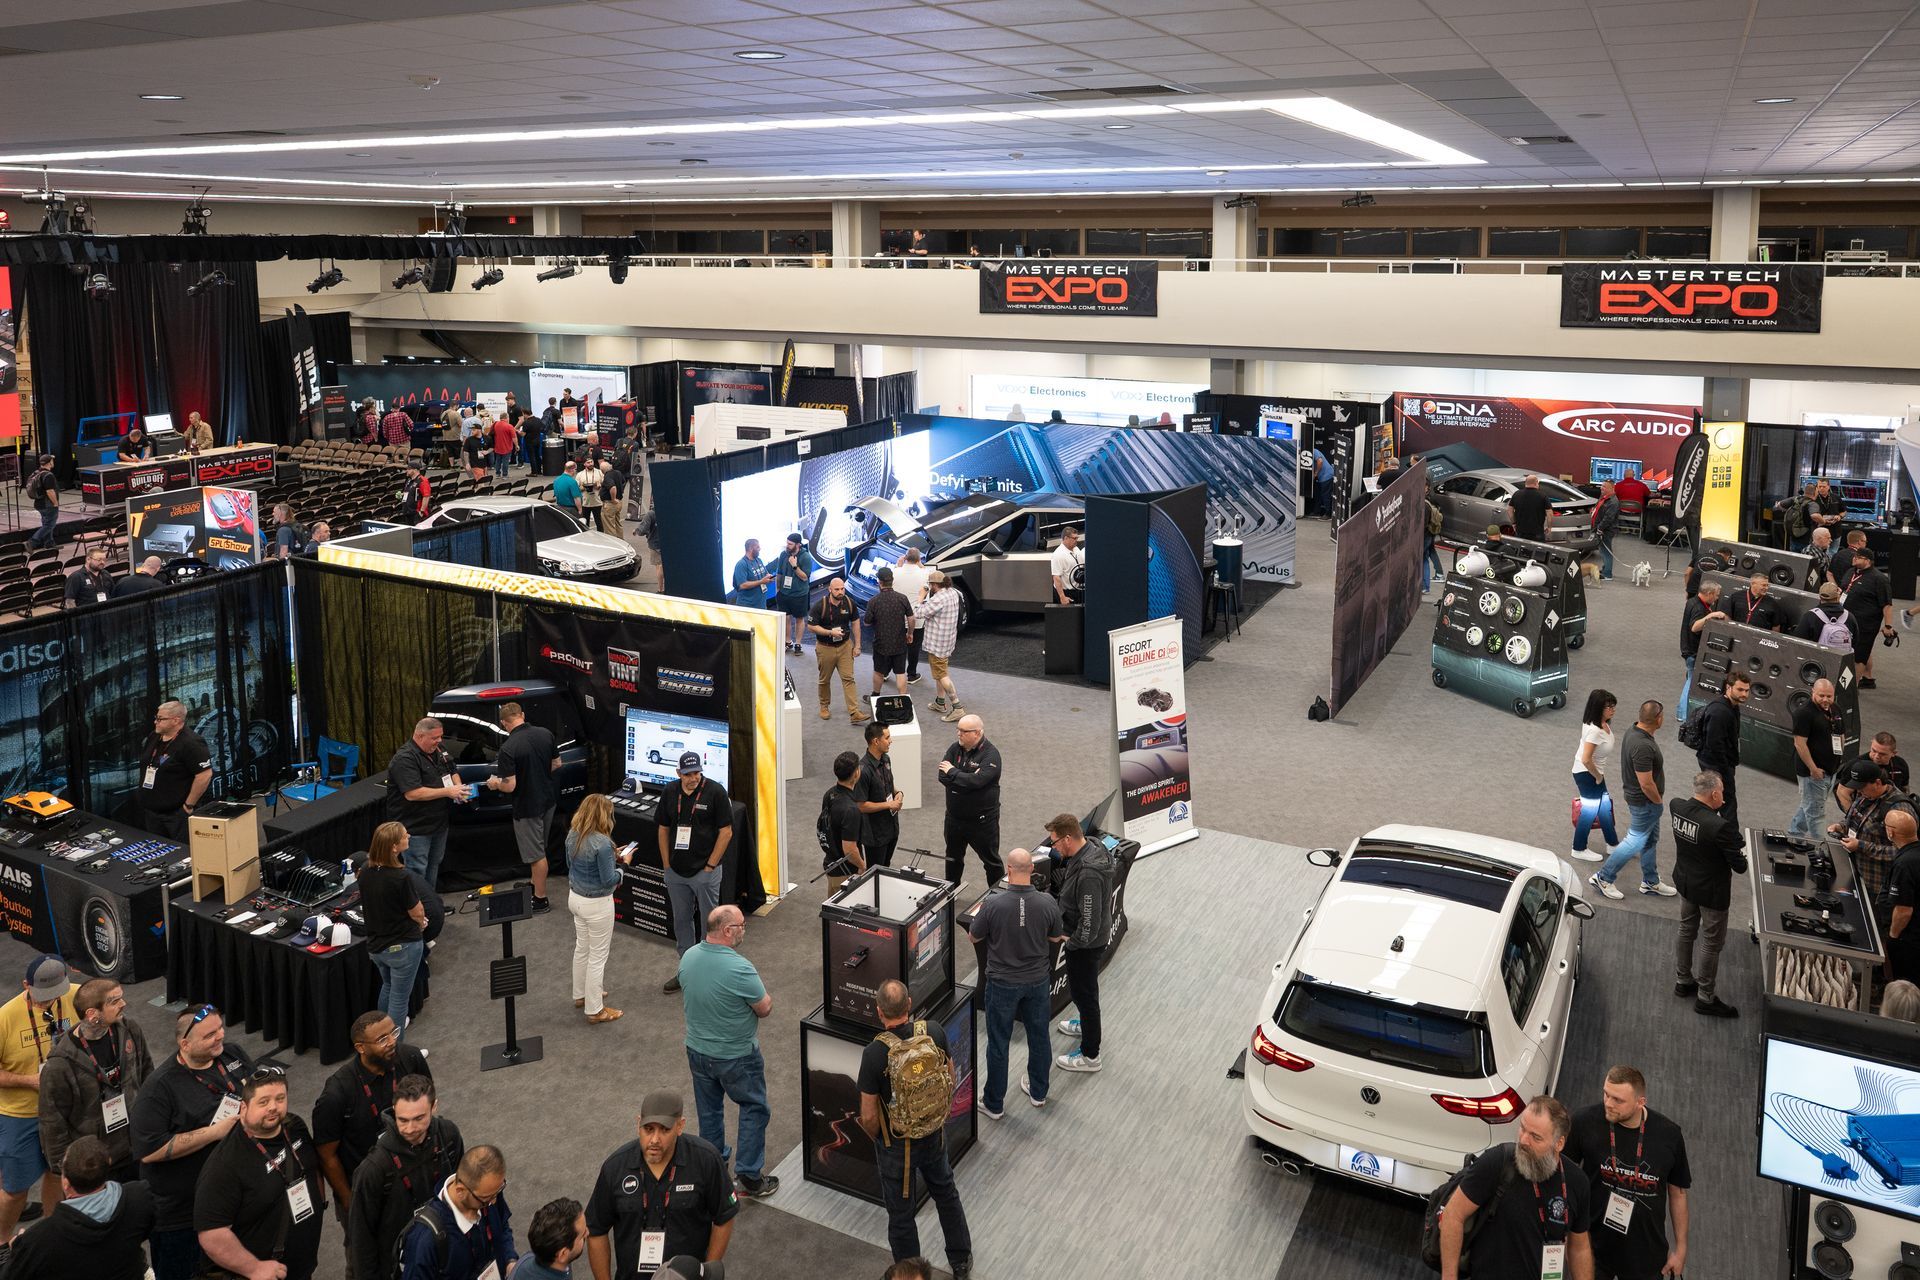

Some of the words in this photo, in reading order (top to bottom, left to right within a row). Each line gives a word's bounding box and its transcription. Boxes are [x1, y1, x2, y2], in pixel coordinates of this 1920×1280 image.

[1006, 265, 1080, 275] MASTER
[1081, 266, 1128, 275] TECH
[1600, 270, 1705, 281] MASTER
[1708, 270, 1780, 282] TECH
[1006, 276, 1128, 304] EXPO
[1600, 284, 1778, 316] EXPO
[1030, 386, 1087, 398] Electronics
[1146, 393, 1194, 403] Electroni
[1260, 404, 1322, 418] SiriusXM
[1436, 402, 1494, 416] DNA
[1570, 419, 1615, 433] ARC
[1620, 421, 1691, 436] AUDIO
[198, 458, 243, 469] MASTER
[245, 454, 271, 463] TECH
[1688, 448, 1704, 479] AUDIO
[199, 459, 272, 481] EXPO
[131, 475, 150, 489] BUILD
[152, 474, 164, 484] OFF
[929, 472, 970, 490] Defyi
[1681, 480, 1692, 506] ARC
[1119, 639, 1152, 655] ESCORT
[1759, 640, 1779, 649] AUDIO
[550, 651, 593, 671] PROTINT
[609, 652, 639, 665] WINDOW
[1123, 650, 1155, 667] REDLINE
[1158, 648, 1165, 658] Ci
[609, 661, 639, 682] TINT
[657, 667, 713, 686] VISUAL
[610, 678, 638, 693] SCHOOL
[658, 680, 714, 696] TINTER
[1137, 782, 1157, 794] DRIVING
[1158, 777, 1176, 788] SPIRIT,
[1141, 782, 1188, 806] AWAKENED
[1169, 813, 1188, 824] MSC
[1673, 816, 1696, 838] BLAM
[632, 886, 666, 900] PROFESSIONAL
[632, 891, 651, 900] WINDOW
[3, 897, 32, 919] Button
[634, 901, 667, 915] PROFESSIONAL
[634, 906, 653, 916] WINDOW
[1084, 894, 1092, 926] SMARTER
[6, 912, 33, 936] System
[634, 917, 667, 931] PROFESSIONAL
[634, 922, 653, 931] WINDOW
[24, 1032, 50, 1041] HUEY
[1350, 1163, 1380, 1178] MSC
